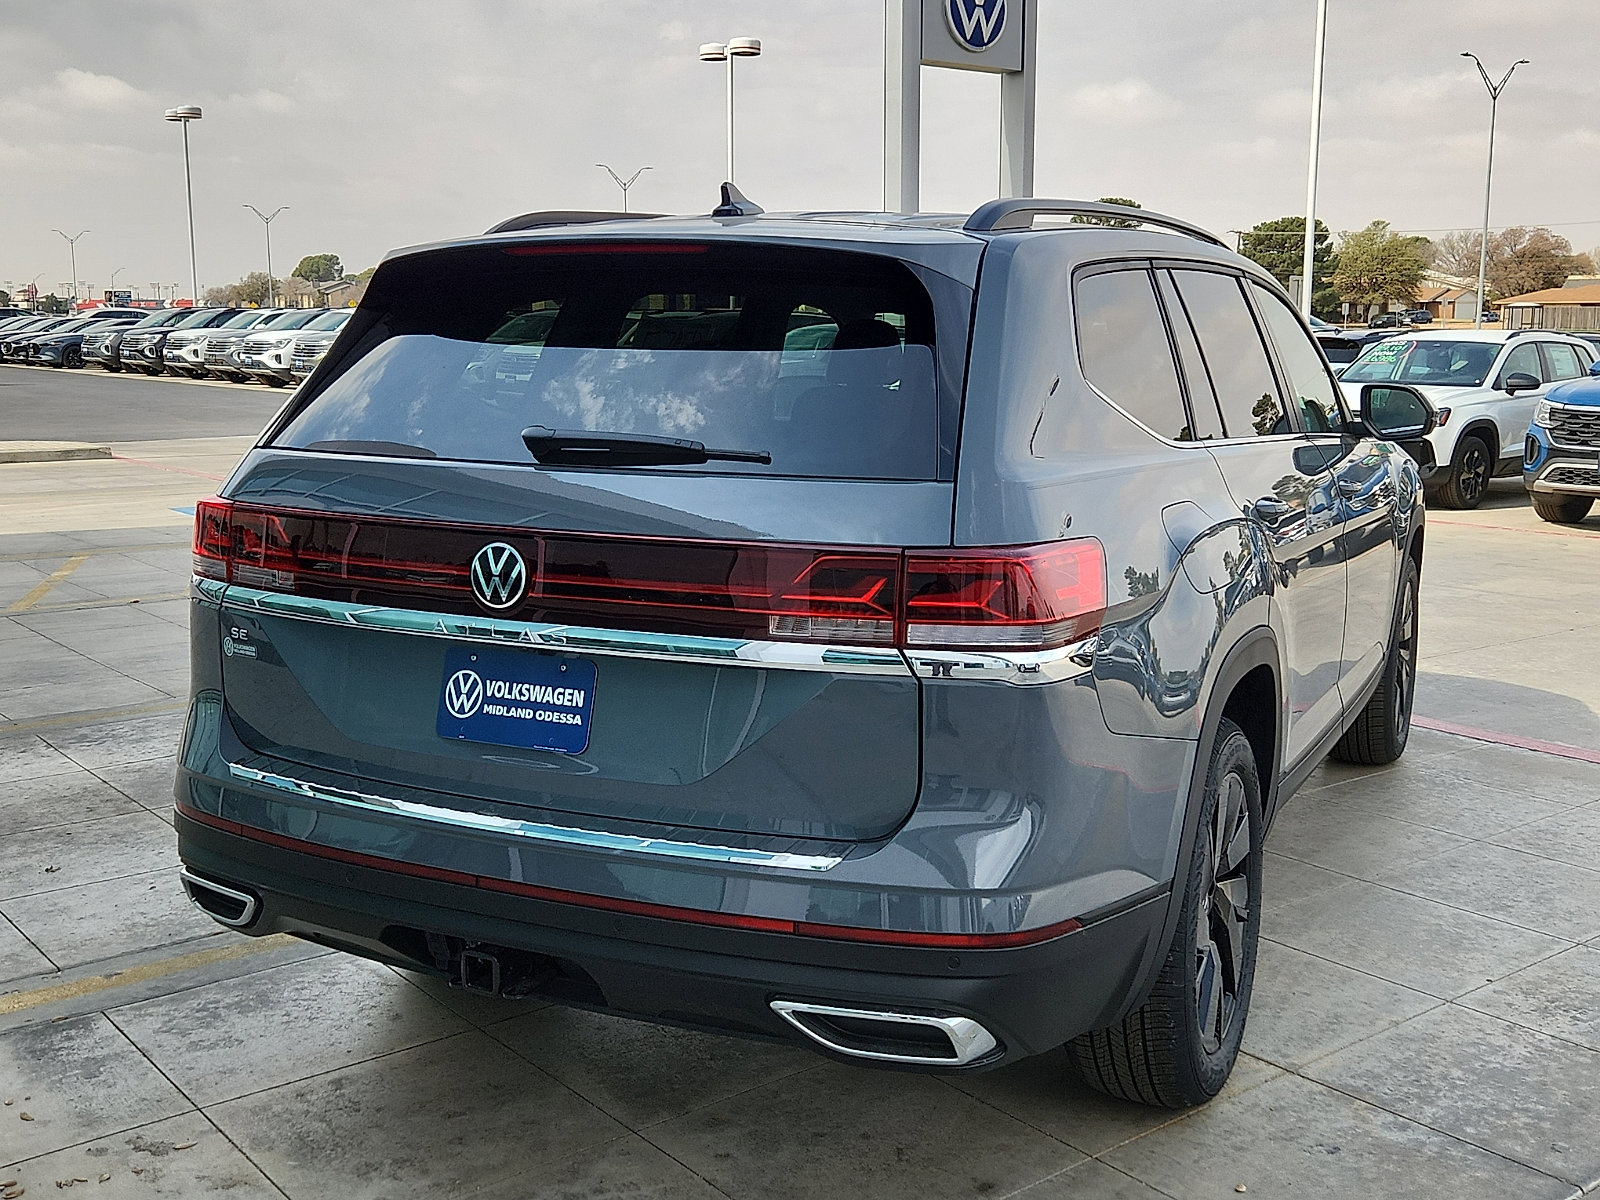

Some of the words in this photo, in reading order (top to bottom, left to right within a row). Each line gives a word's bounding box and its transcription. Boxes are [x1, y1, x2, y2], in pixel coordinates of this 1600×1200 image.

[231, 627, 248, 640] SE
[432, 618, 567, 645] ATLAS
[485, 679, 585, 708] VOLKSWAGEN
[482, 703, 534, 720] MIDLAND
[535, 709, 583, 726] ODESSA
